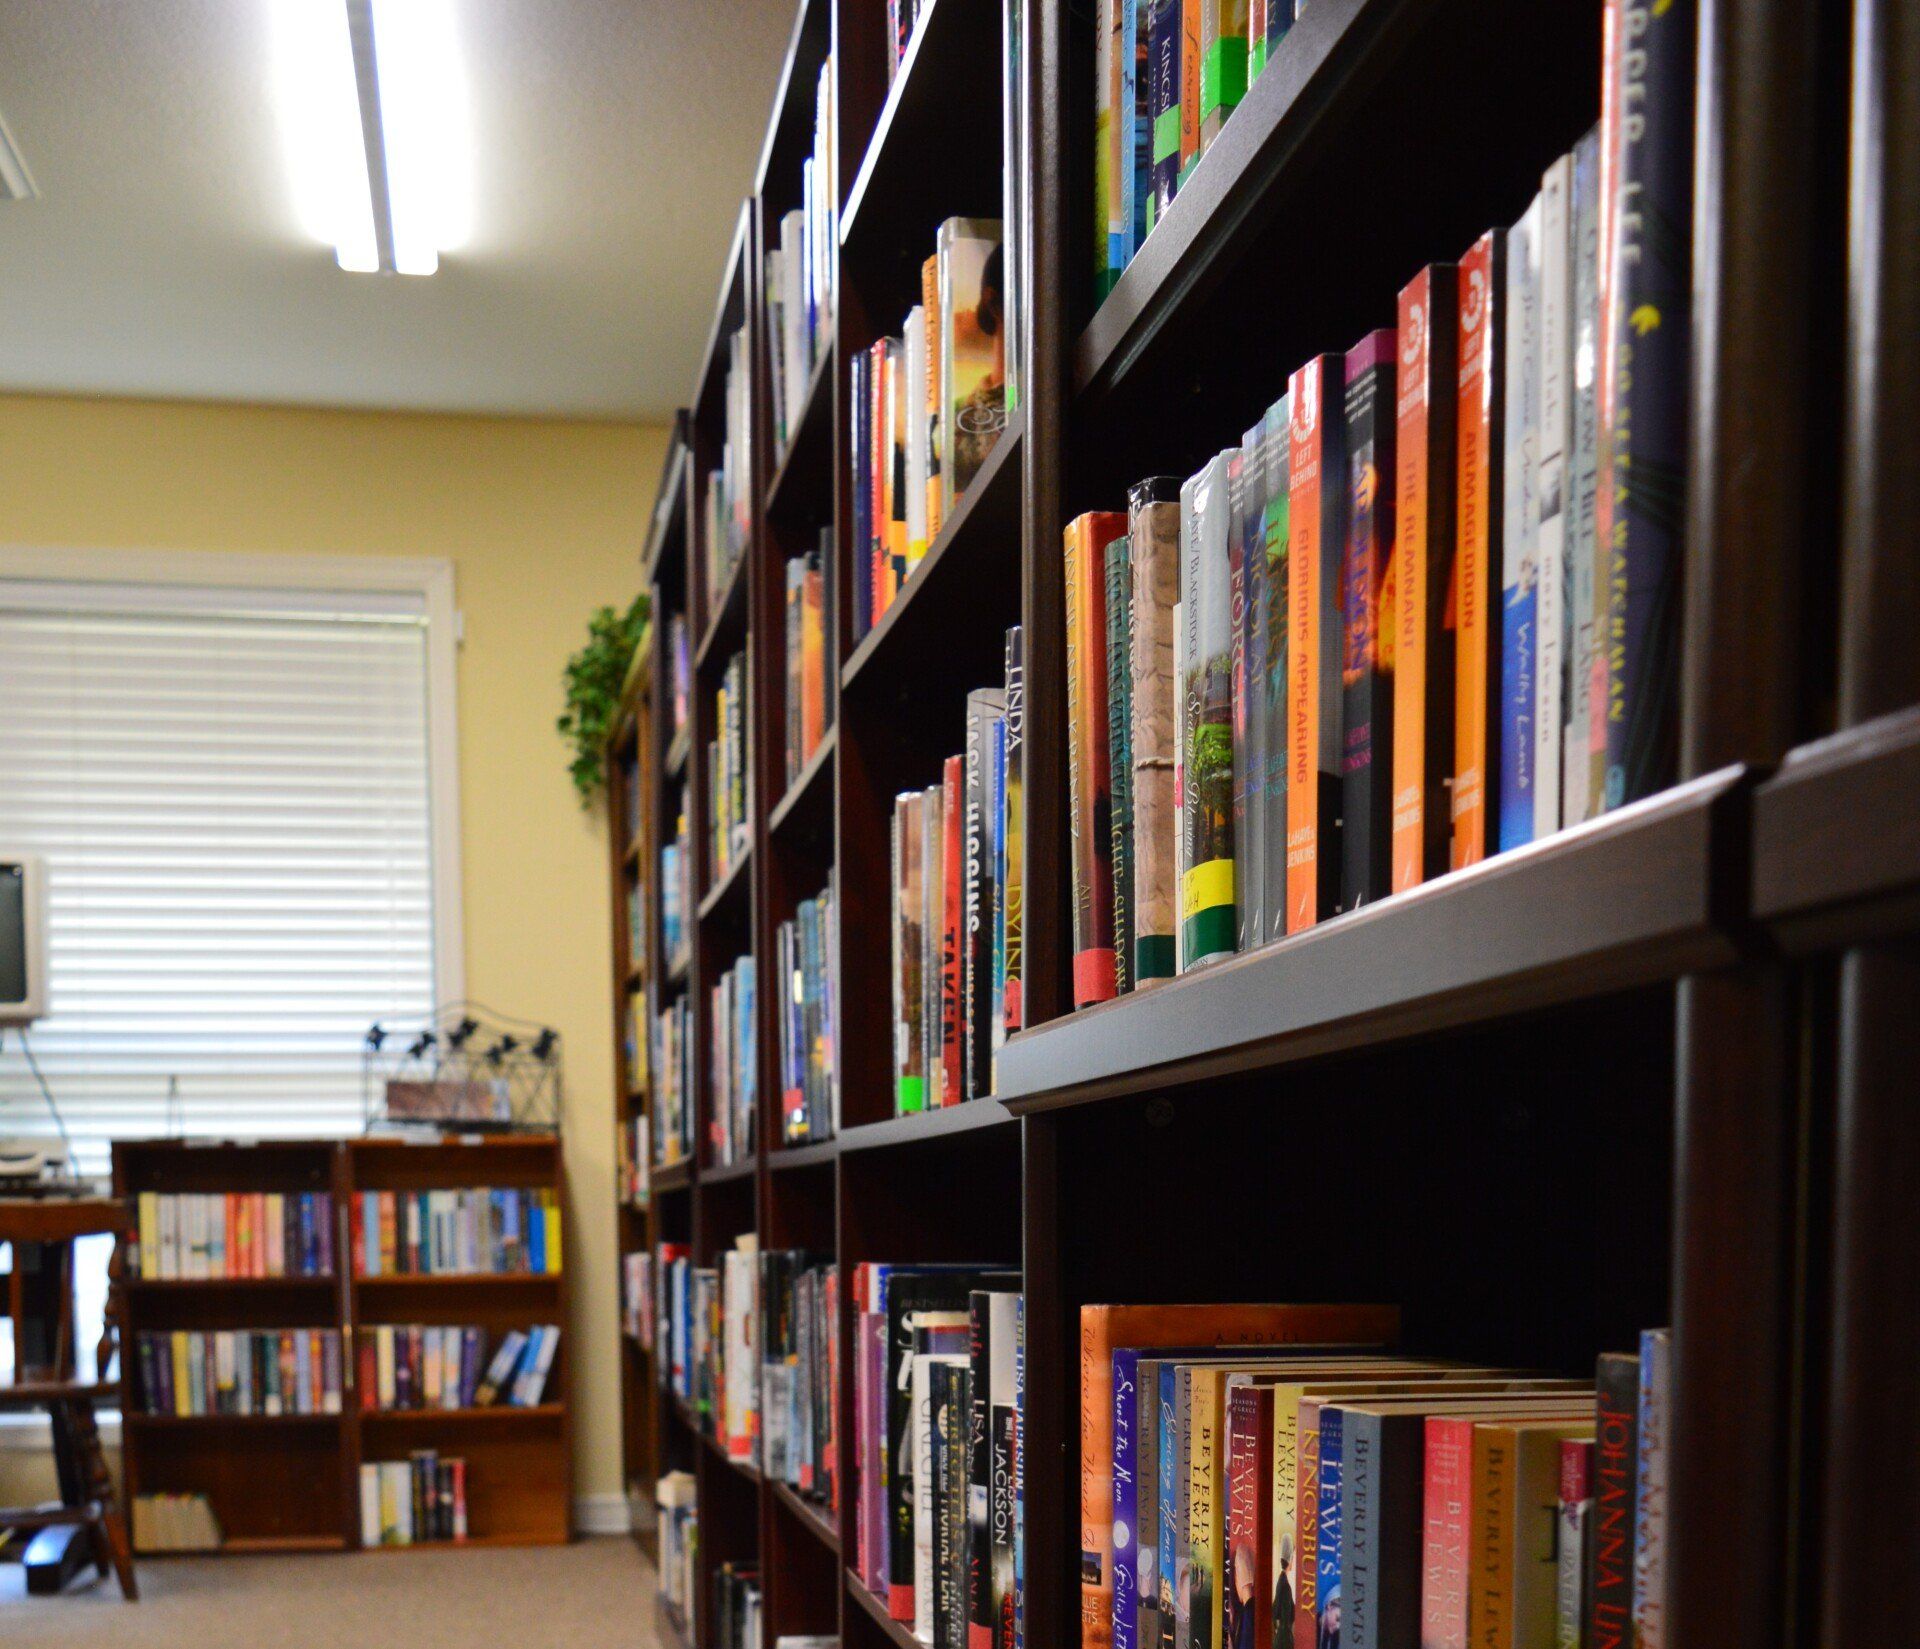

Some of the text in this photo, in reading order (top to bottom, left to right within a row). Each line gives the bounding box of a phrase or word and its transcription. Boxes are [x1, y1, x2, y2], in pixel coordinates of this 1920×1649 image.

[1290, 460, 1317, 491] BEHIND
[1401, 460, 1416, 649] THE REMNANT
[1462, 432, 1478, 628] ARMAGEDDON
[1296, 529, 1309, 784] GLORIOUS APPEARING
[1608, 519, 1628, 723] WATCHMAN
[967, 714, 981, 788] JACK
[1008, 665, 1023, 753] LINDA
[967, 800, 981, 933] HIGGINS
[1184, 778, 1202, 860] Blessing
[1288, 844, 1315, 867] JENKINS
[943, 926, 956, 1046] TAKEN
[1083, 1326, 1096, 1403] Where
[1239, 1331, 1301, 1344] NOVEL
[974, 1400, 986, 1443] LISA
[1083, 1410, 1096, 1442] the
[1112, 1365, 1134, 1506] Shoot the Moon
[1277, 1429, 1287, 1503] LEWIS
[1285, 1415, 1297, 1521] BEVERLY
[994, 1443, 1008, 1546] JACKSON
[1082, 1452, 1096, 1521] Heart
[1140, 1461, 1151, 1533] LEWIS
[1160, 1399, 1176, 1564] Coming Home
[1192, 1465, 1201, 1547] LEWIS
[1201, 1426, 1211, 1549] BEVERLY
[1231, 1432, 1245, 1537] LEWIS
[1243, 1435, 1257, 1542] BEVERLY
[1301, 1428, 1319, 1621] KINGSBURY
[1320, 1459, 1338, 1577] LEWIS
[1485, 1446, 1505, 1575] BEVERLY
[1598, 1409, 1635, 1589] JOHANNA
[1114, 1563, 1134, 1613] Billie
[1351, 1438, 1369, 1646] BEVERLY LEWIS
[1427, 1518, 1444, 1626] LEWIS
[1446, 1501, 1462, 1648] BEVERLY
